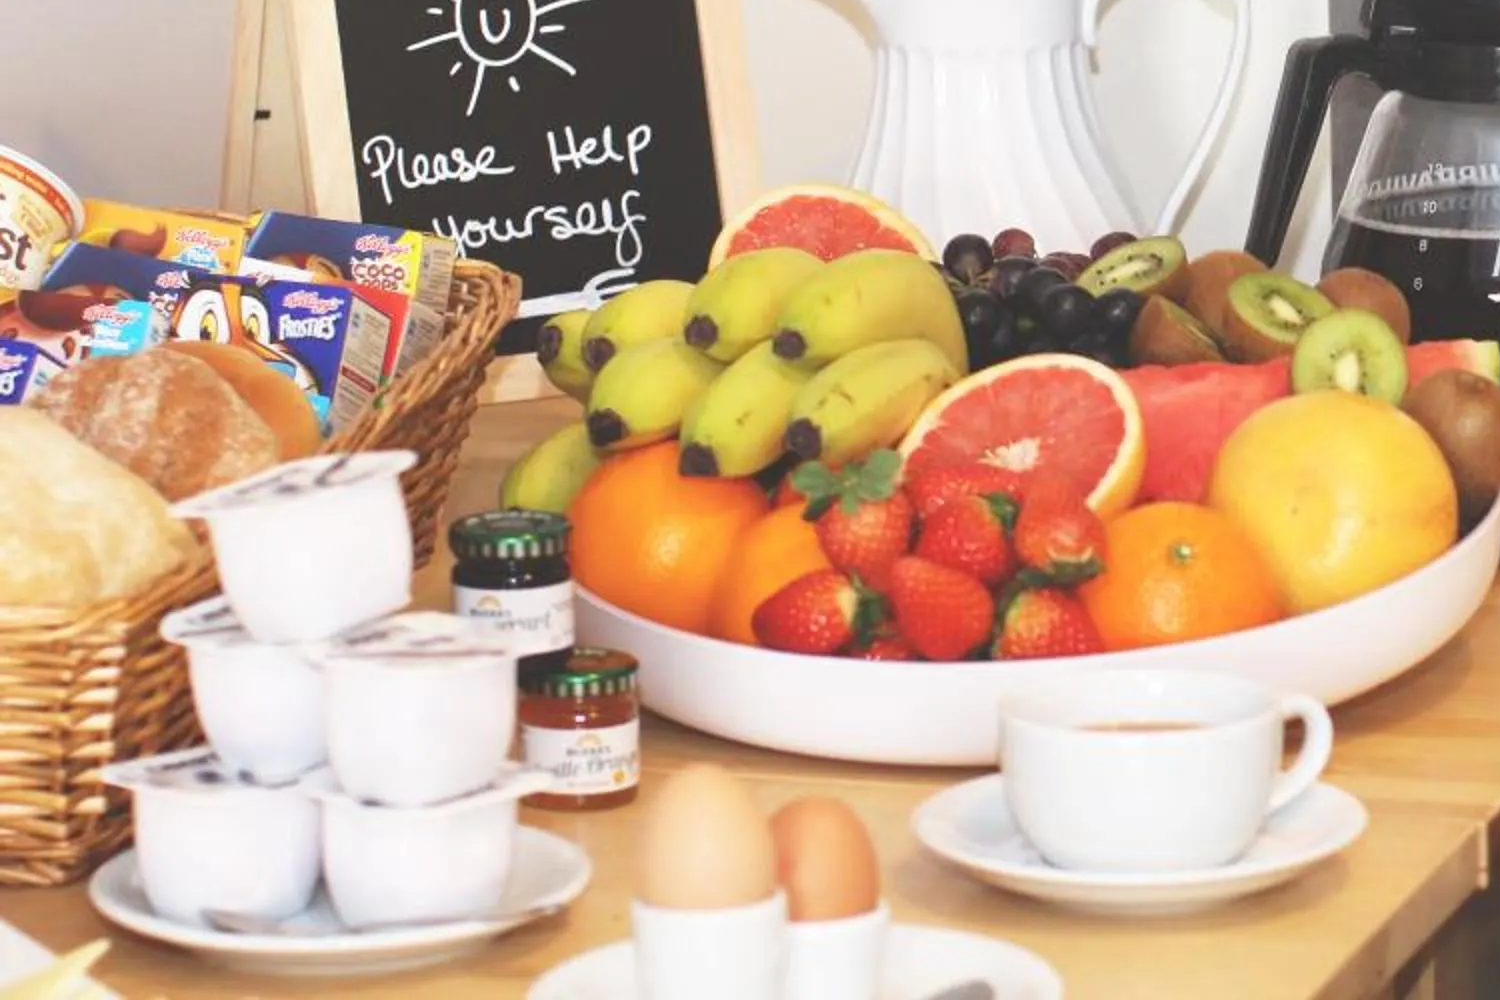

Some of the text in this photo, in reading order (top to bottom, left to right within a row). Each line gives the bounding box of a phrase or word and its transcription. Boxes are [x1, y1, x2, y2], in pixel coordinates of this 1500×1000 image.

[362, 124, 653, 205] Please Help
[431, 189, 647, 267] yourself
[353, 262, 406, 281] COCO
